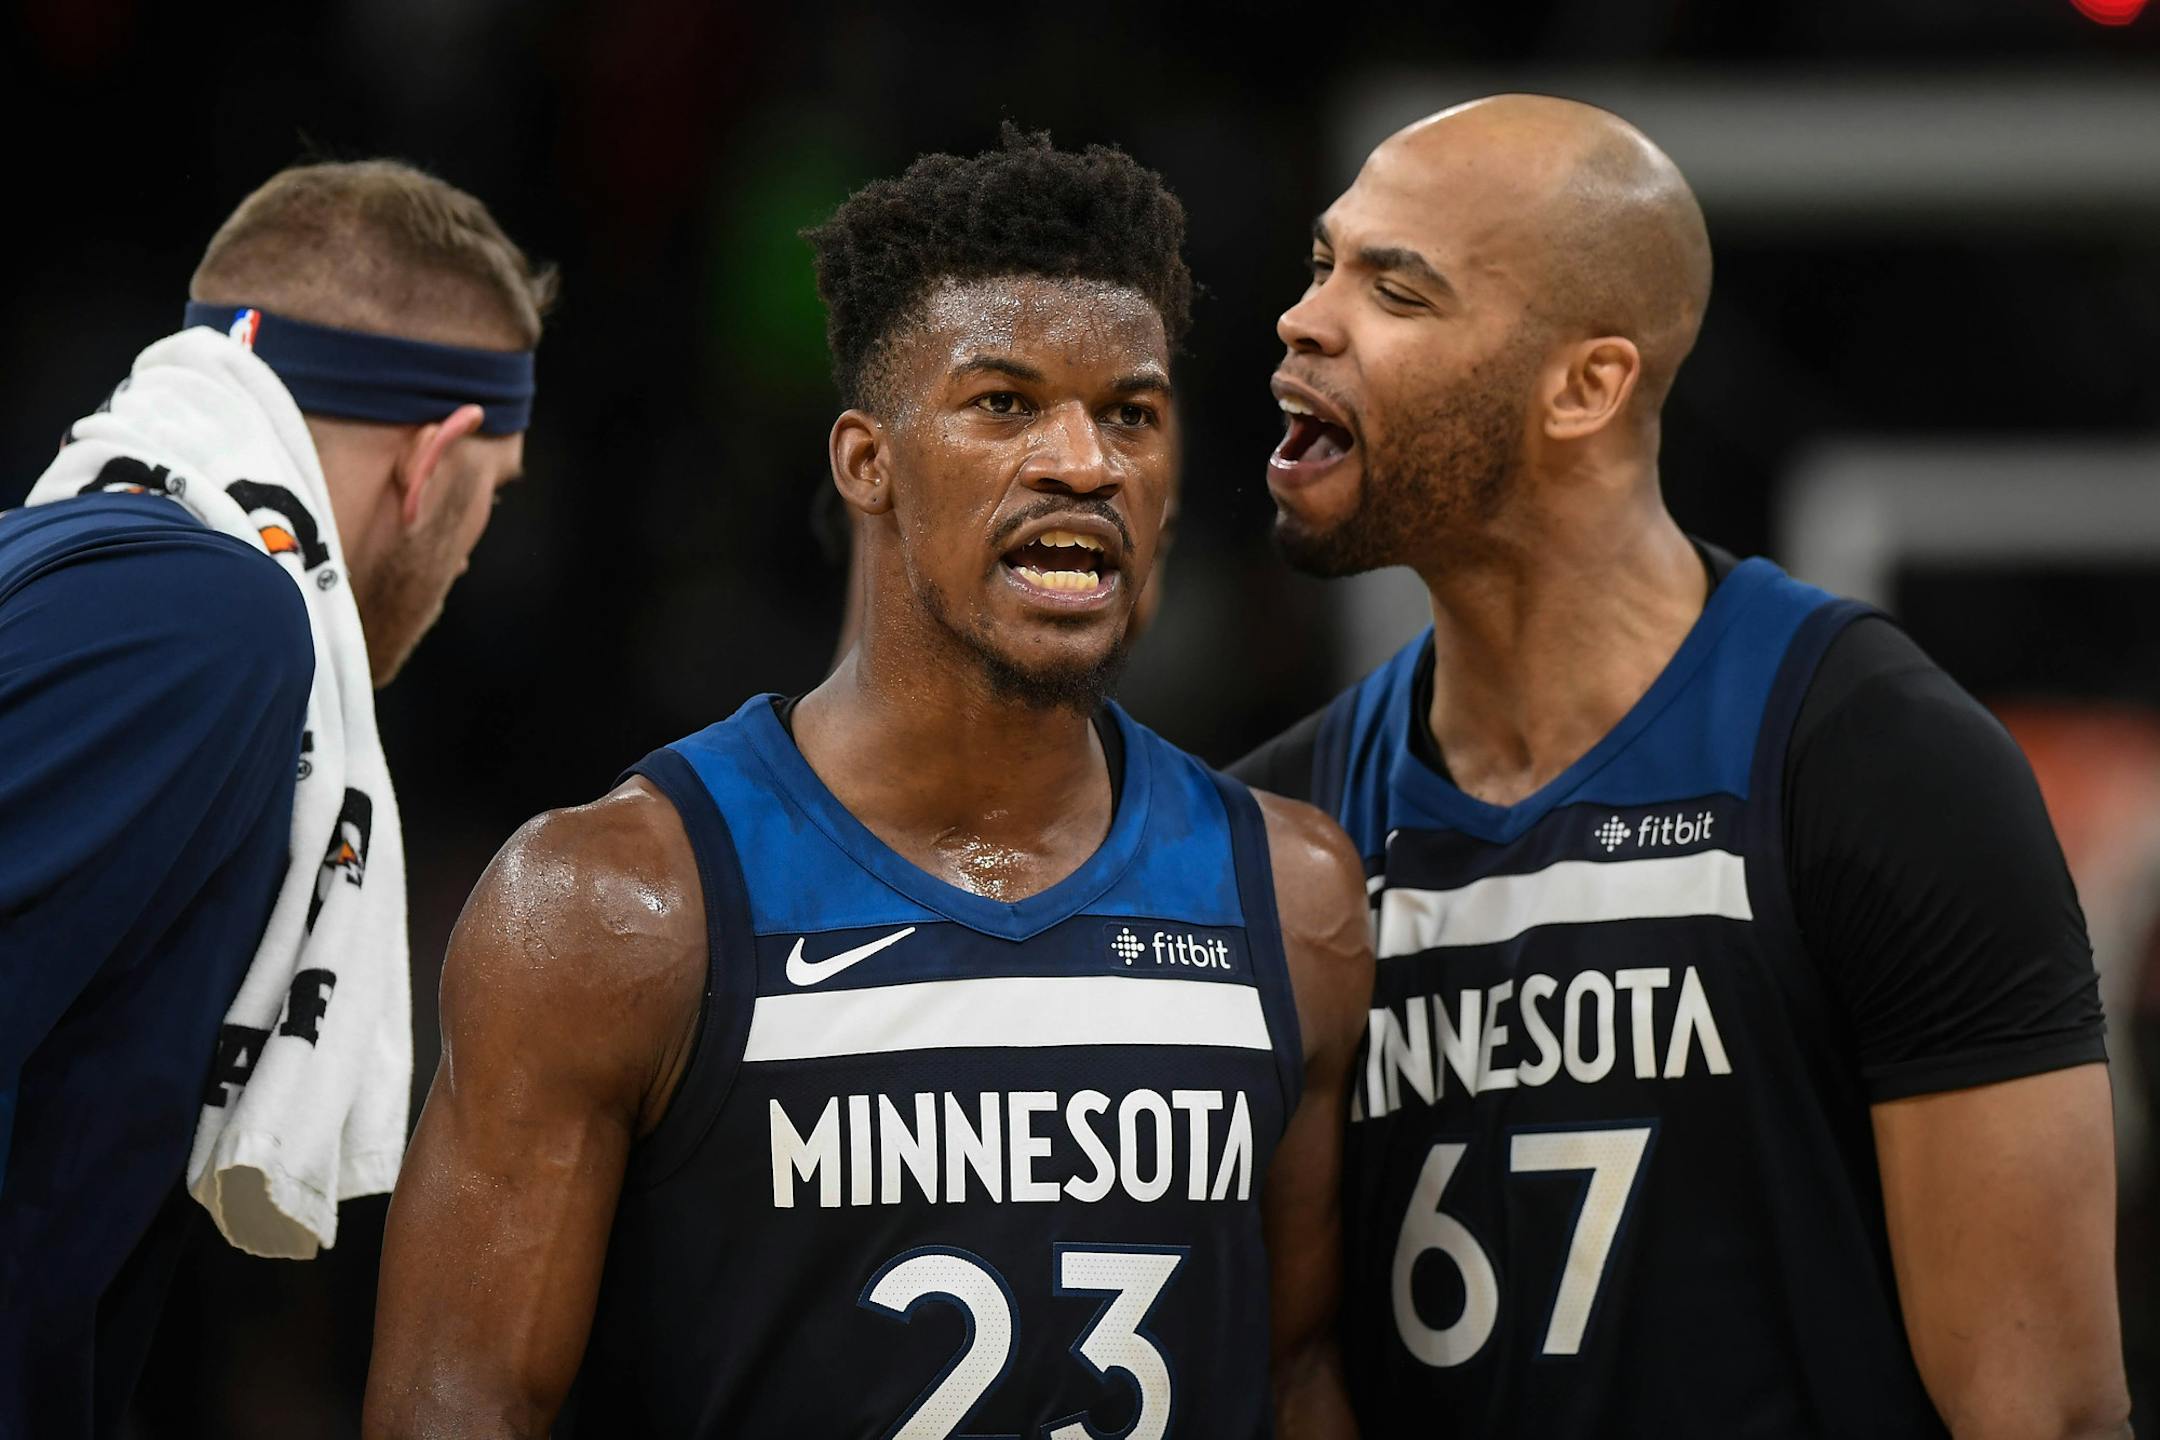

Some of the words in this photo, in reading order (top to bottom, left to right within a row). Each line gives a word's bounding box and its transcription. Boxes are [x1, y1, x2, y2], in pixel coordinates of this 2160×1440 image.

[1637, 811, 1714, 848] fitbit
[1151, 931, 1231, 970] fitbit
[1351, 966, 1732, 1123] INNESOTA
[769, 1088, 1253, 1209] MINNESOTA
[1391, 1126, 1653, 1368] 67
[866, 1250, 1183, 1440] 23
